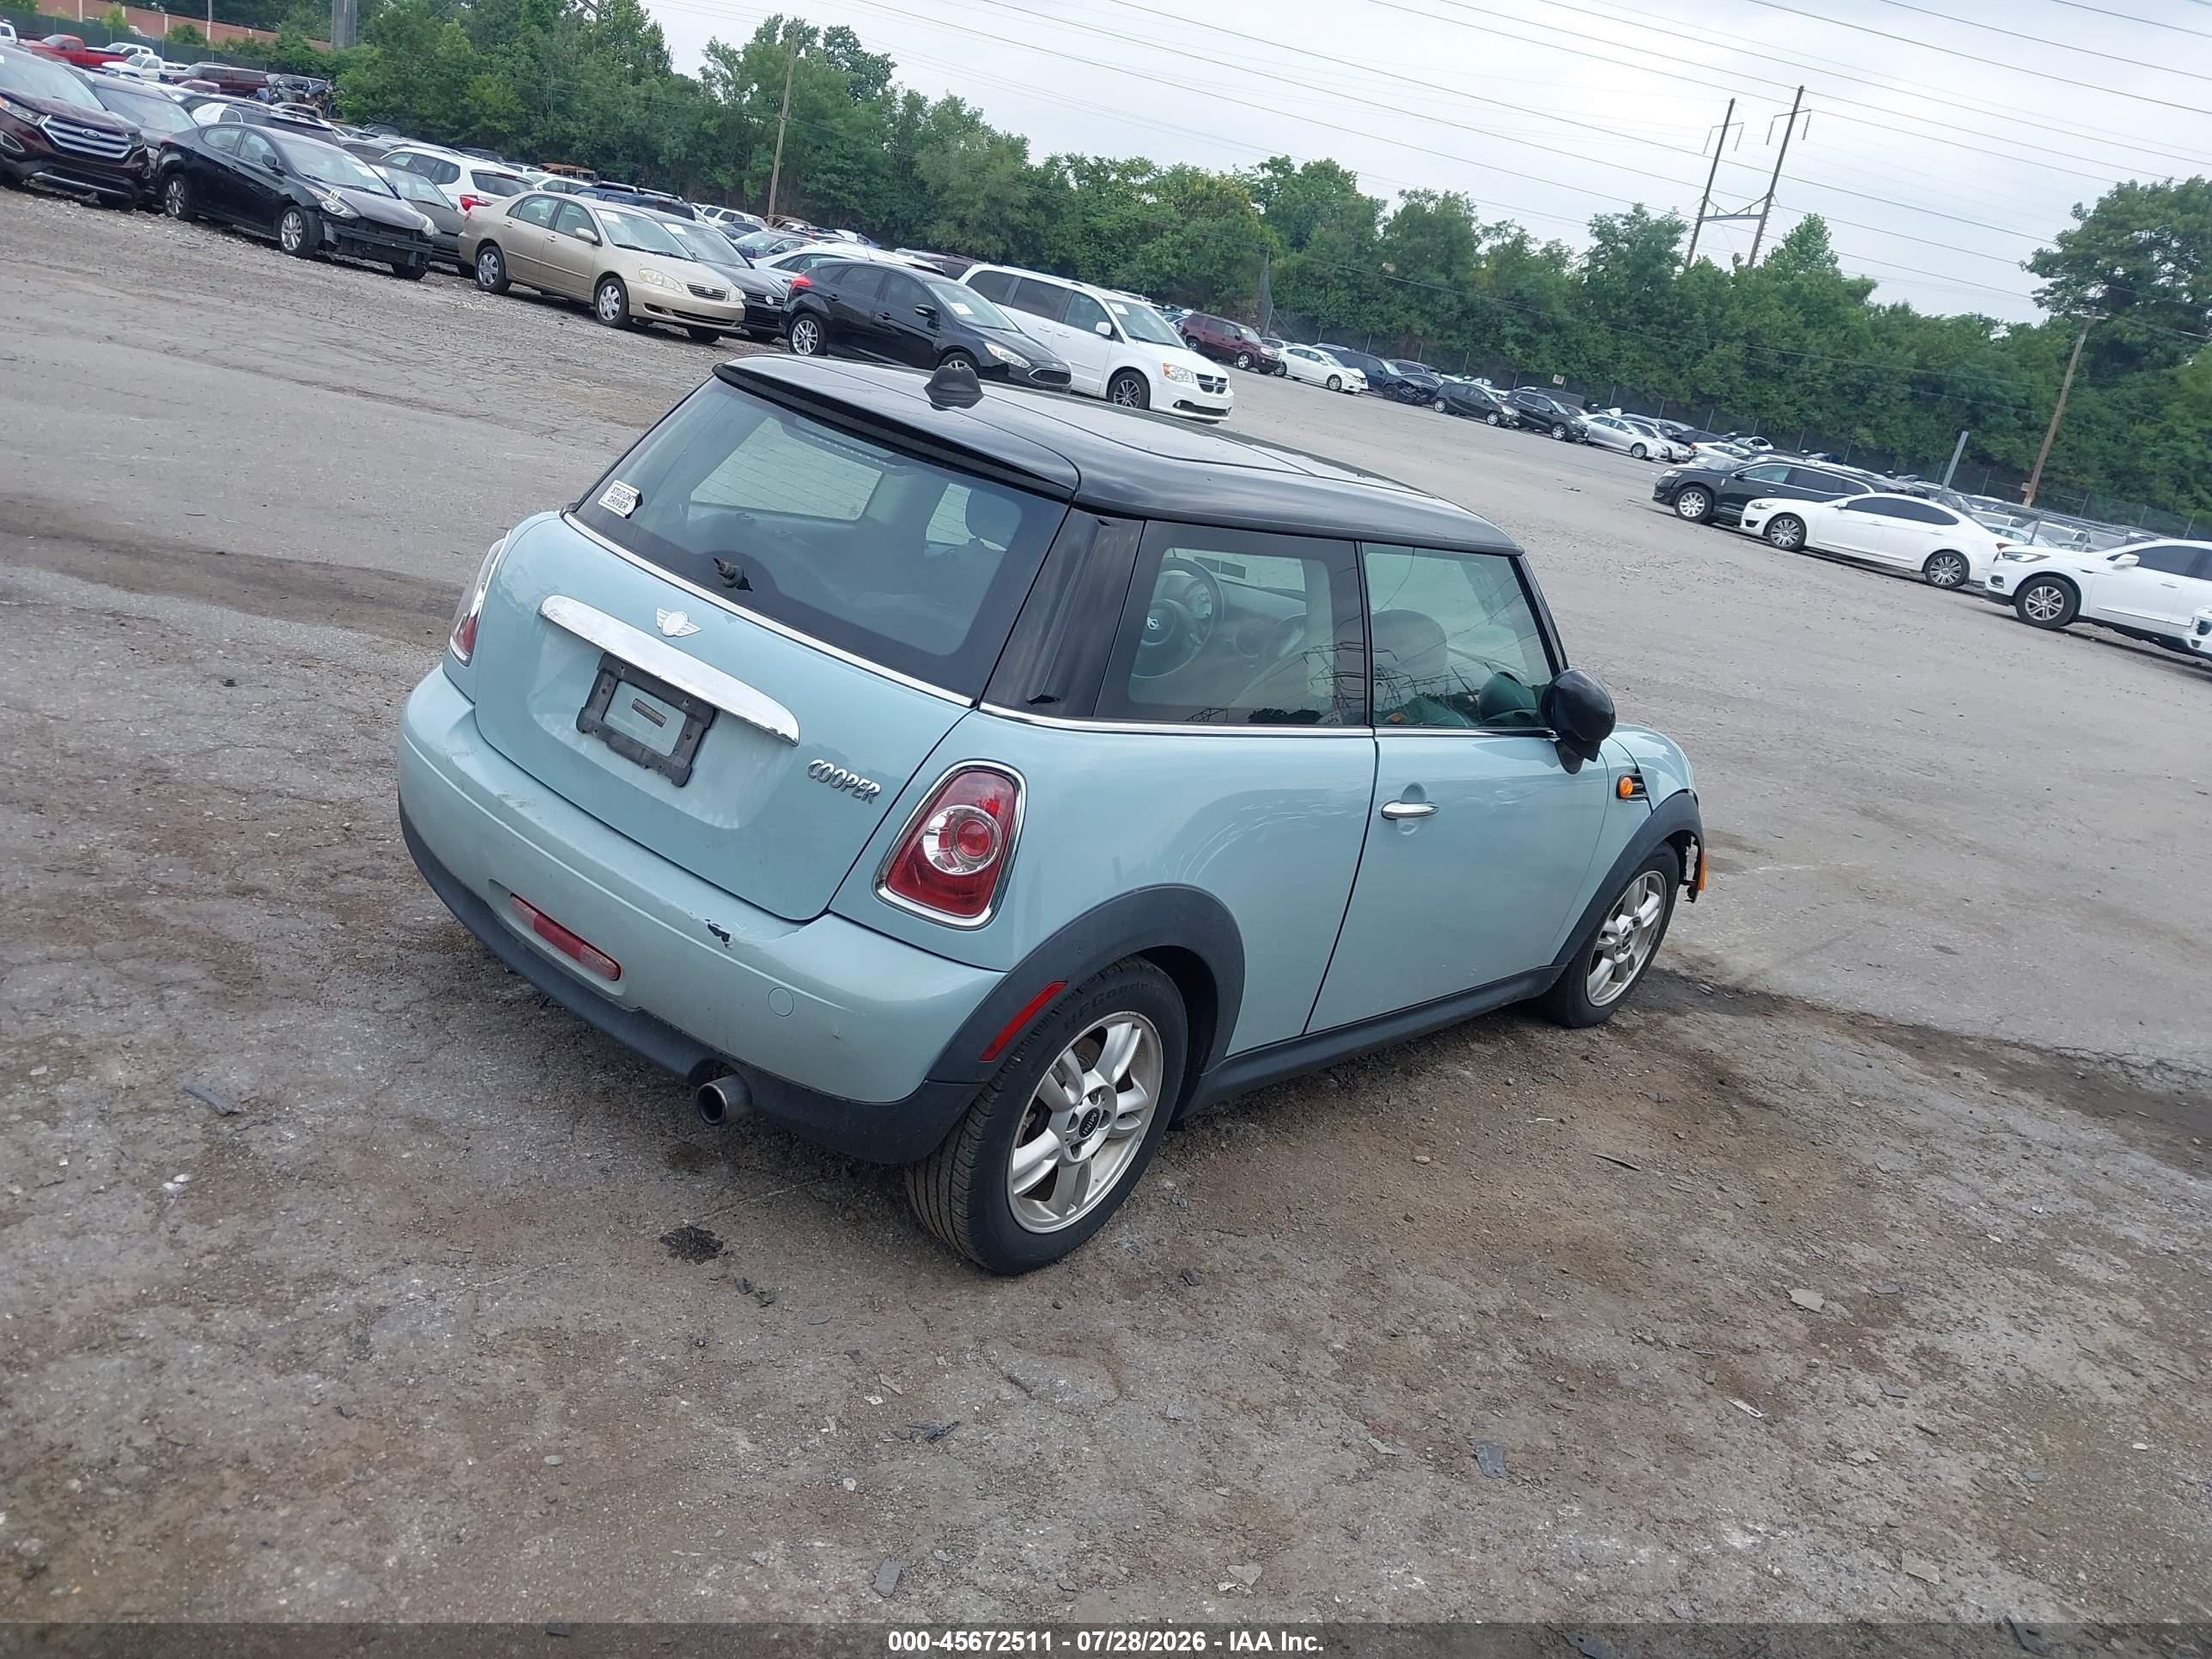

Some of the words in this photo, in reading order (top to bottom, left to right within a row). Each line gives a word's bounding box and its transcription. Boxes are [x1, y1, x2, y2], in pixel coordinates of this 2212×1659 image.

[607, 495, 629, 510] DRIVER
[807, 759, 881, 805] COOPER
[1082, 1112, 1097, 1134] MINI
